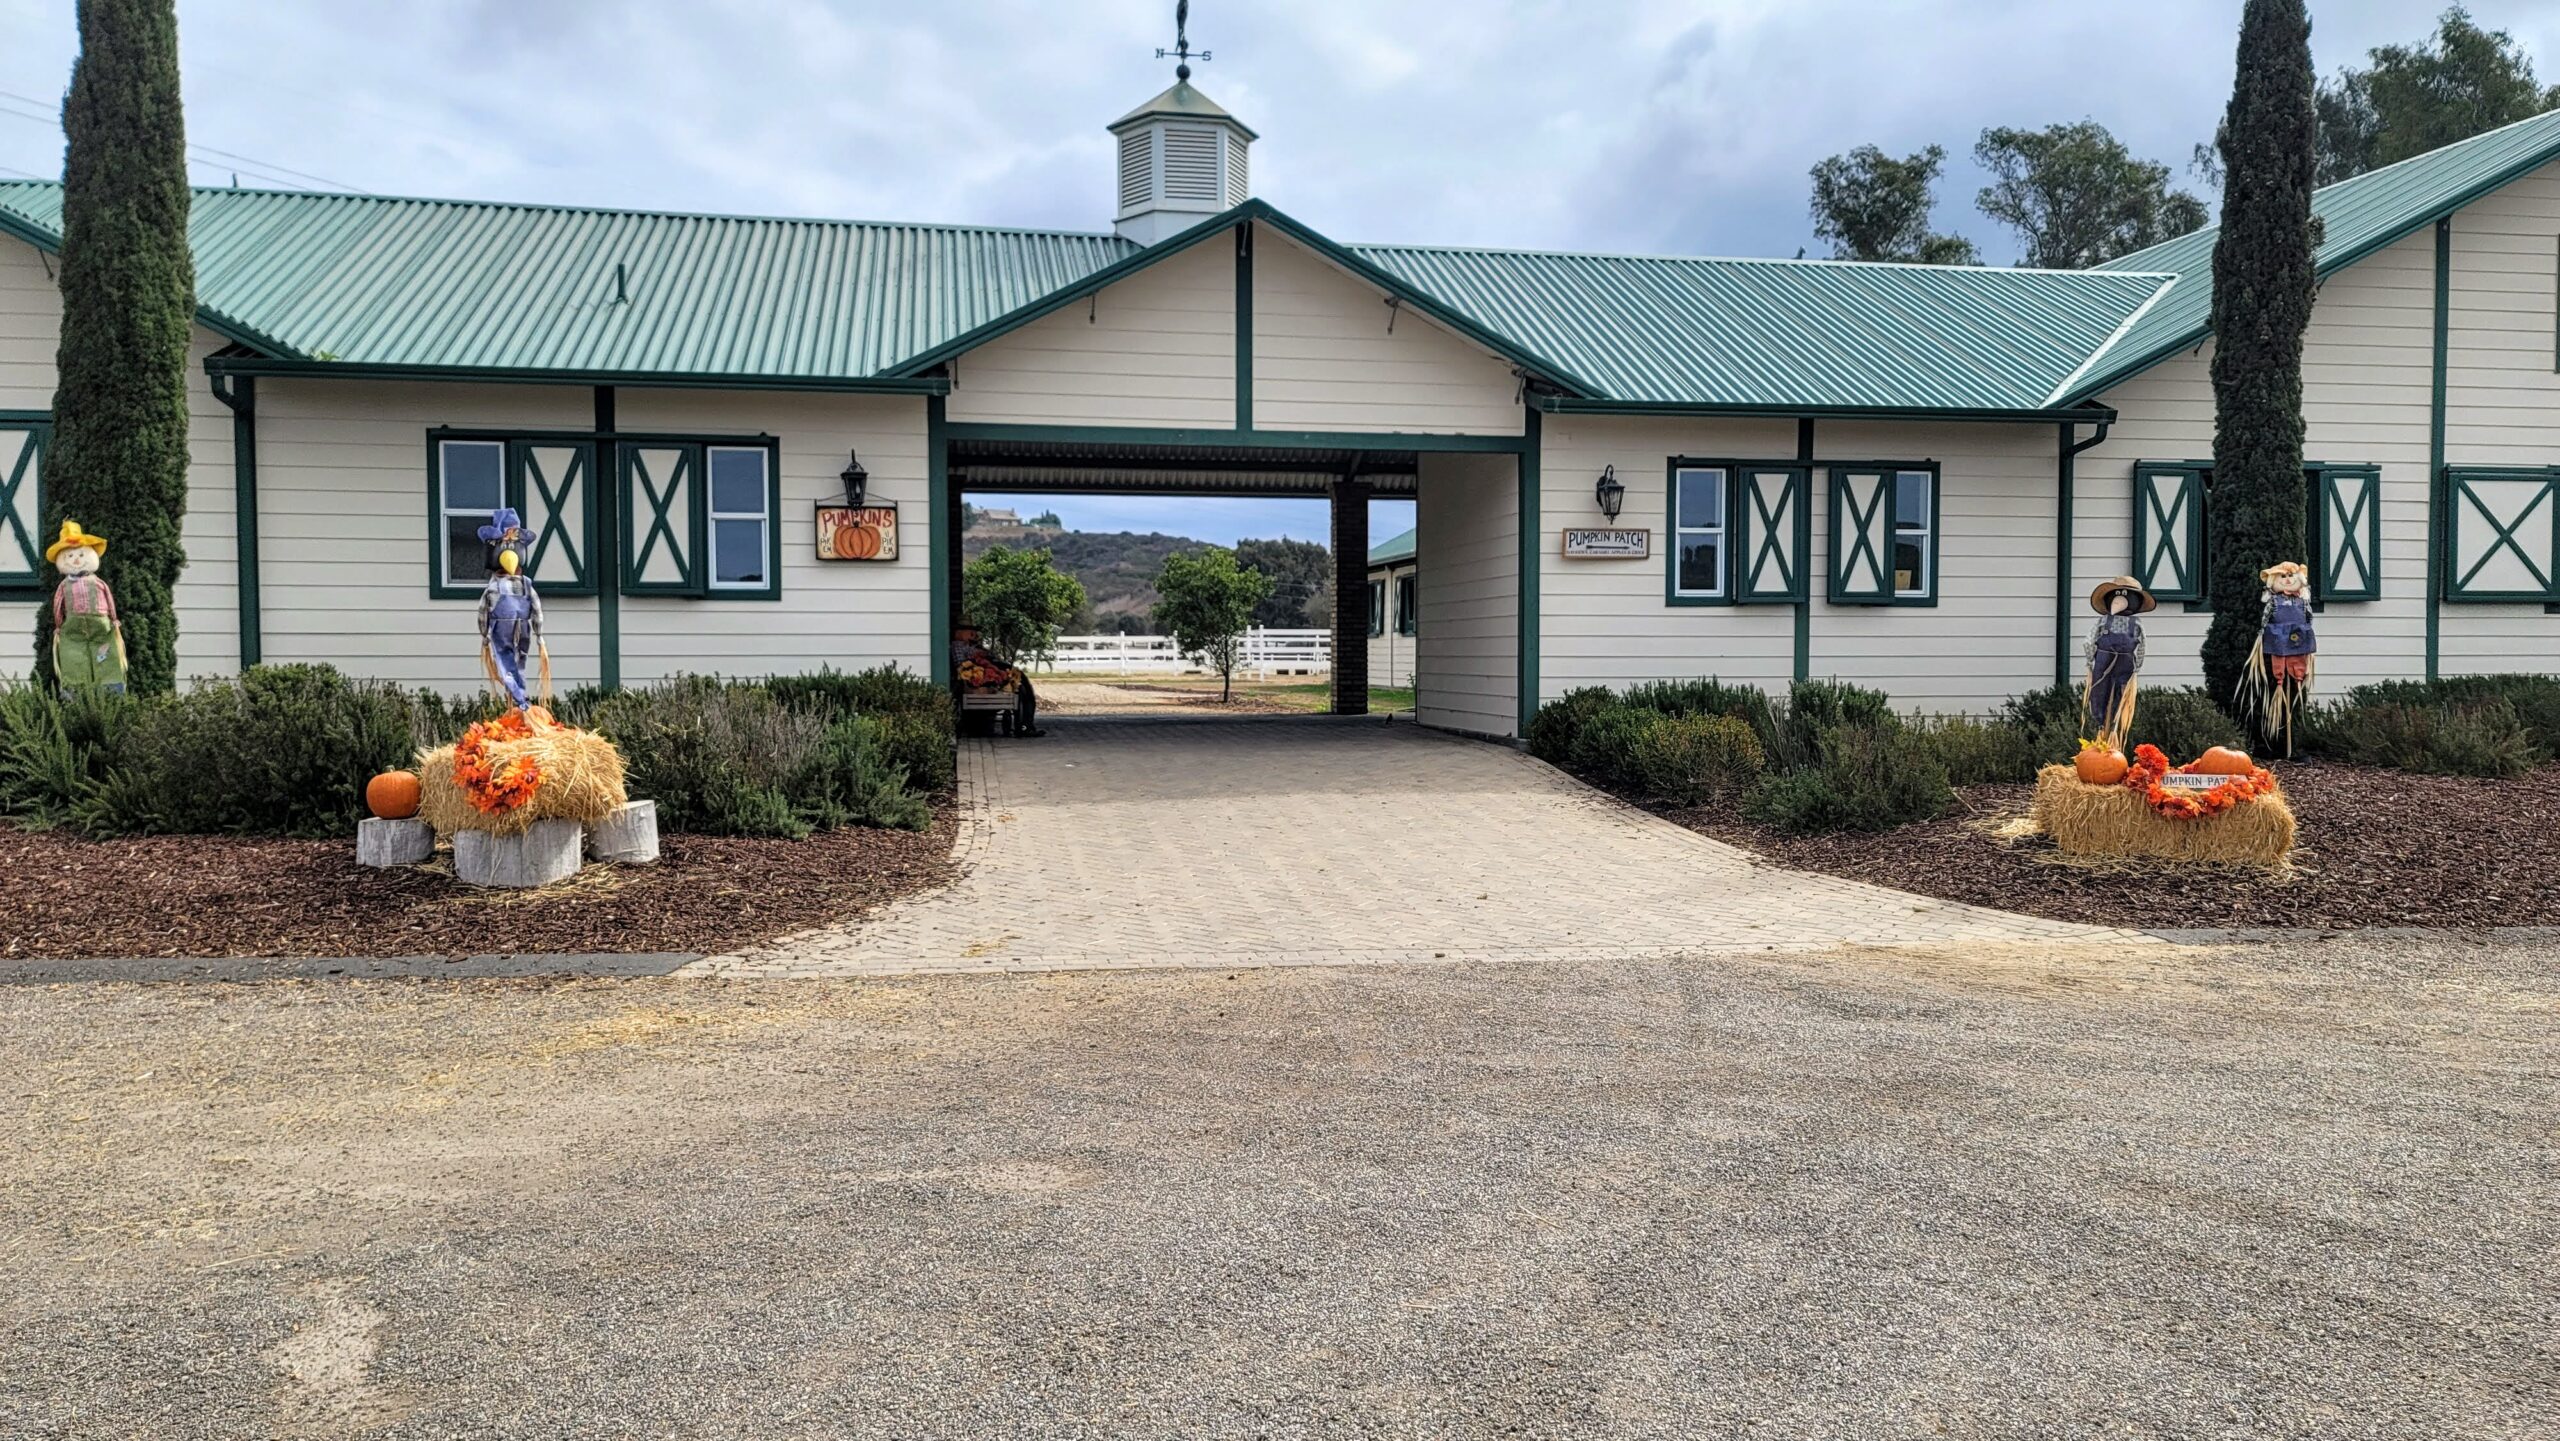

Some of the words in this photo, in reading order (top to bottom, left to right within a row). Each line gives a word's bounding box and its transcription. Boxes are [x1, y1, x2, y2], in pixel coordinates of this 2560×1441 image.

[1155, 48, 1164, 59] N
[1202, 50, 1212, 61] S
[821, 509, 893, 534] PUMPKINS
[1568, 532, 1610, 548] PUMPKIN
[1614, 532, 1644, 549] PATCH
[2161, 776, 2202, 786] UMPKIN
